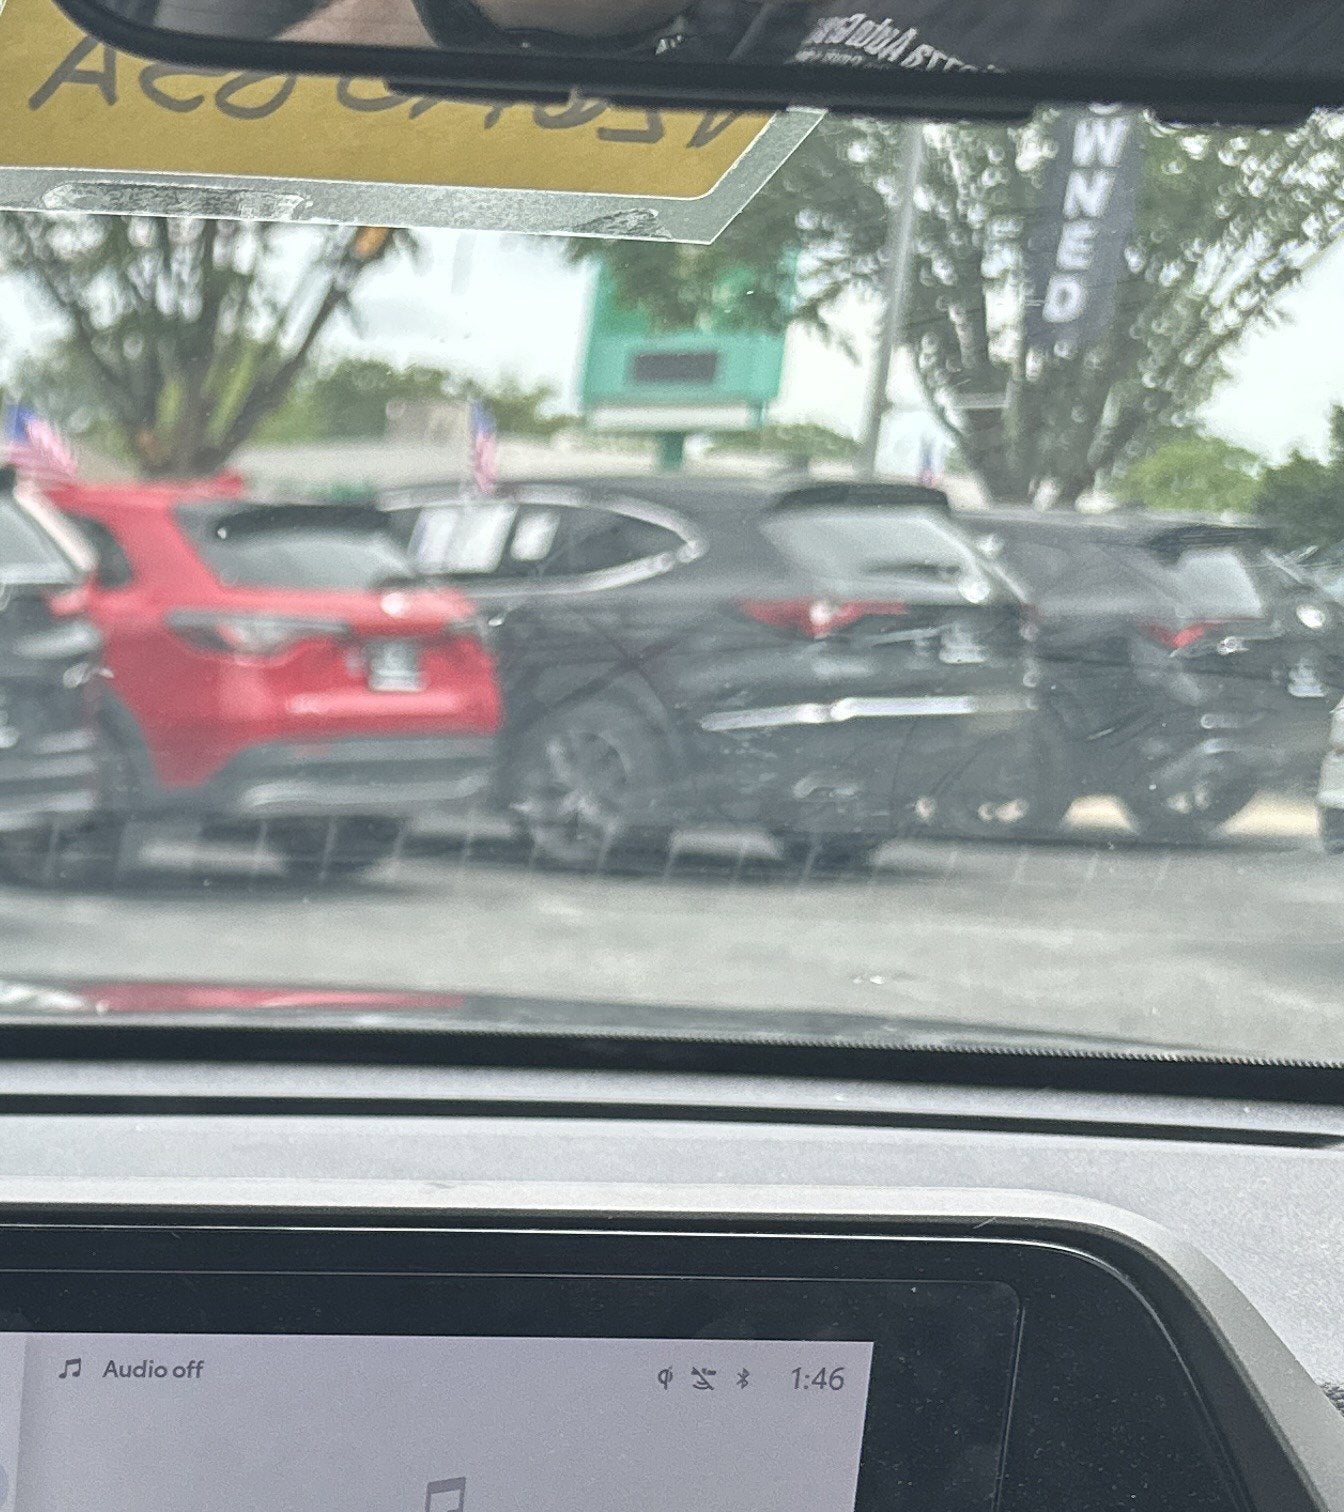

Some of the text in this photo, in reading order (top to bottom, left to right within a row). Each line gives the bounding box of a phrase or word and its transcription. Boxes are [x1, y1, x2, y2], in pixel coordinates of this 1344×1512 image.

[1041, 103, 1130, 323] WNED
[102, 1359, 205, 1379] Audio off
[791, 1366, 846, 1391] 1:46
